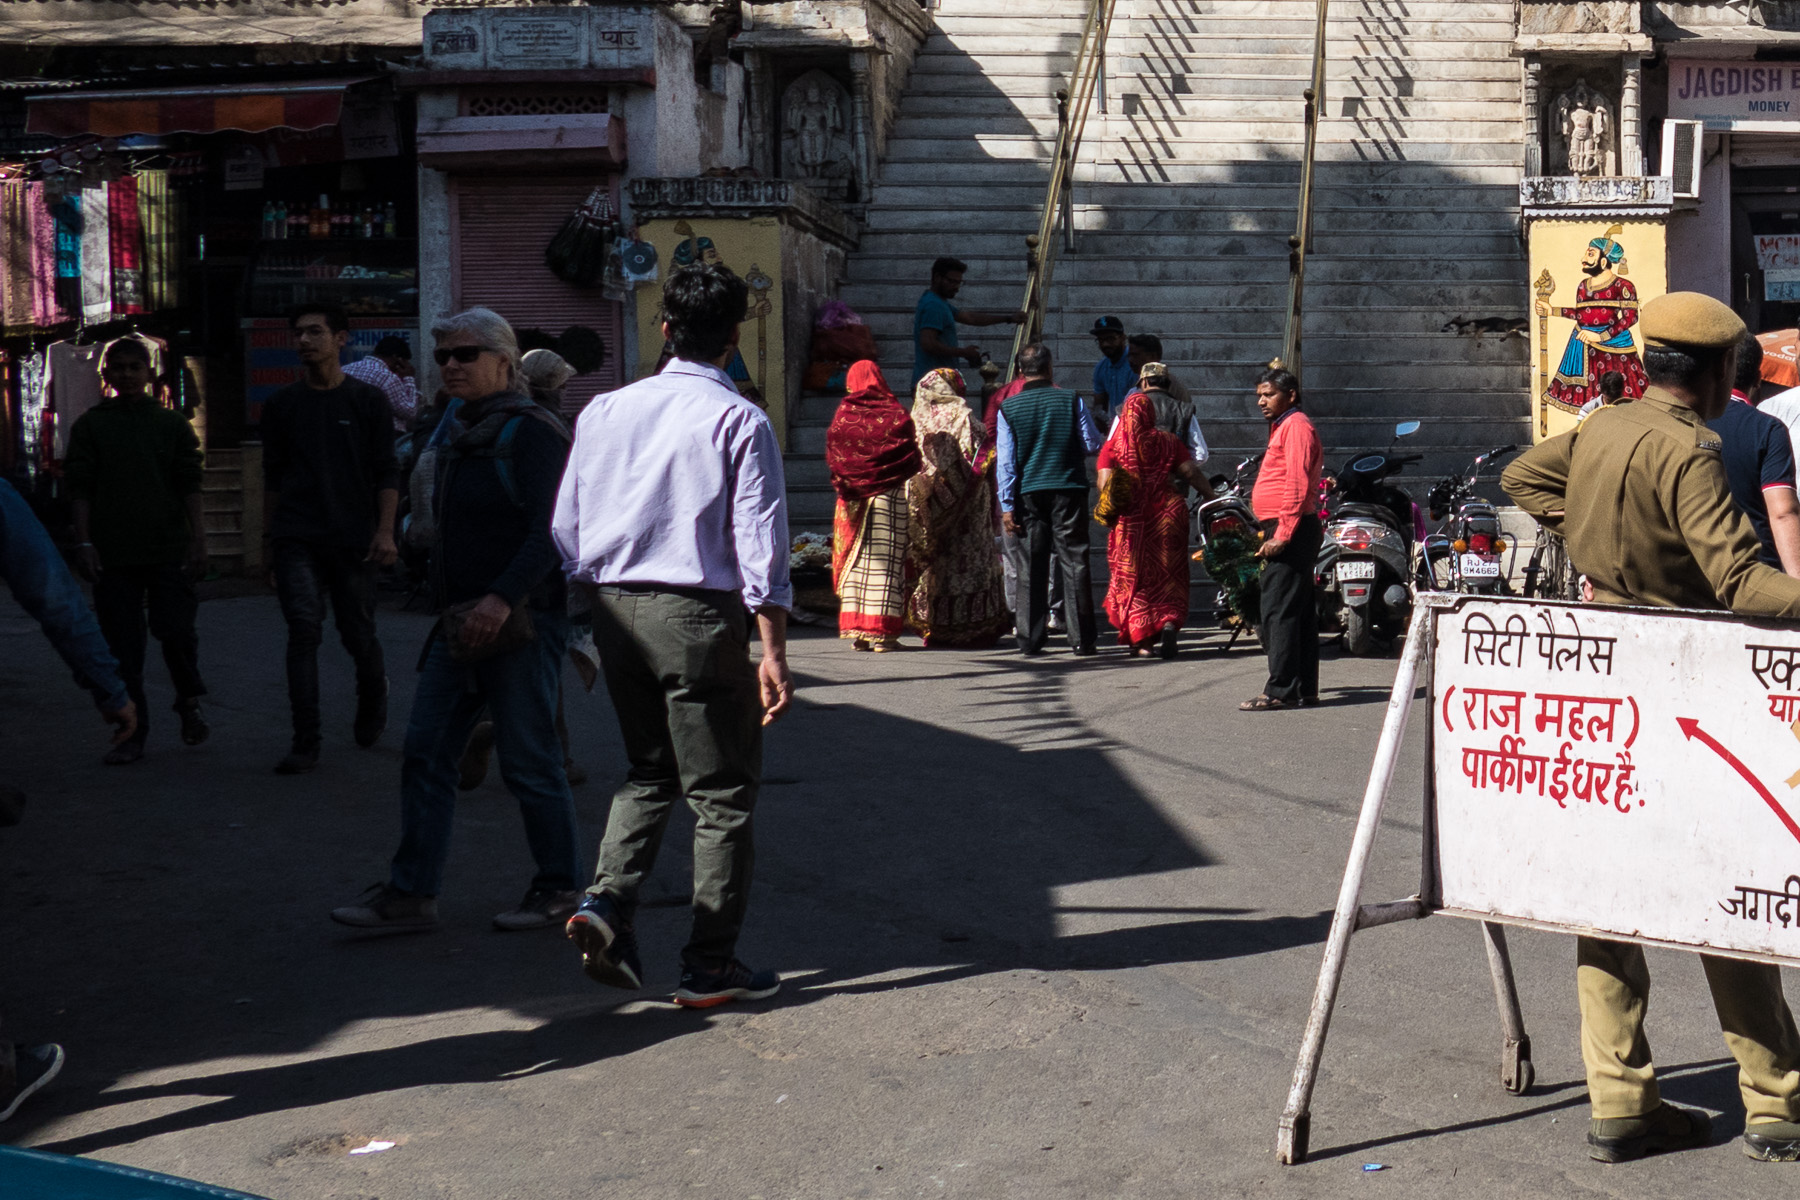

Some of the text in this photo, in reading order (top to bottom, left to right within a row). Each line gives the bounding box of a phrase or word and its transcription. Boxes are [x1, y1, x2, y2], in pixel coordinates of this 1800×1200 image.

[1678, 66, 1783, 100] JAGDISH
[1748, 100, 1790, 113] MONEY
[1462, 608, 1618, 676] सिटी पैलेस
